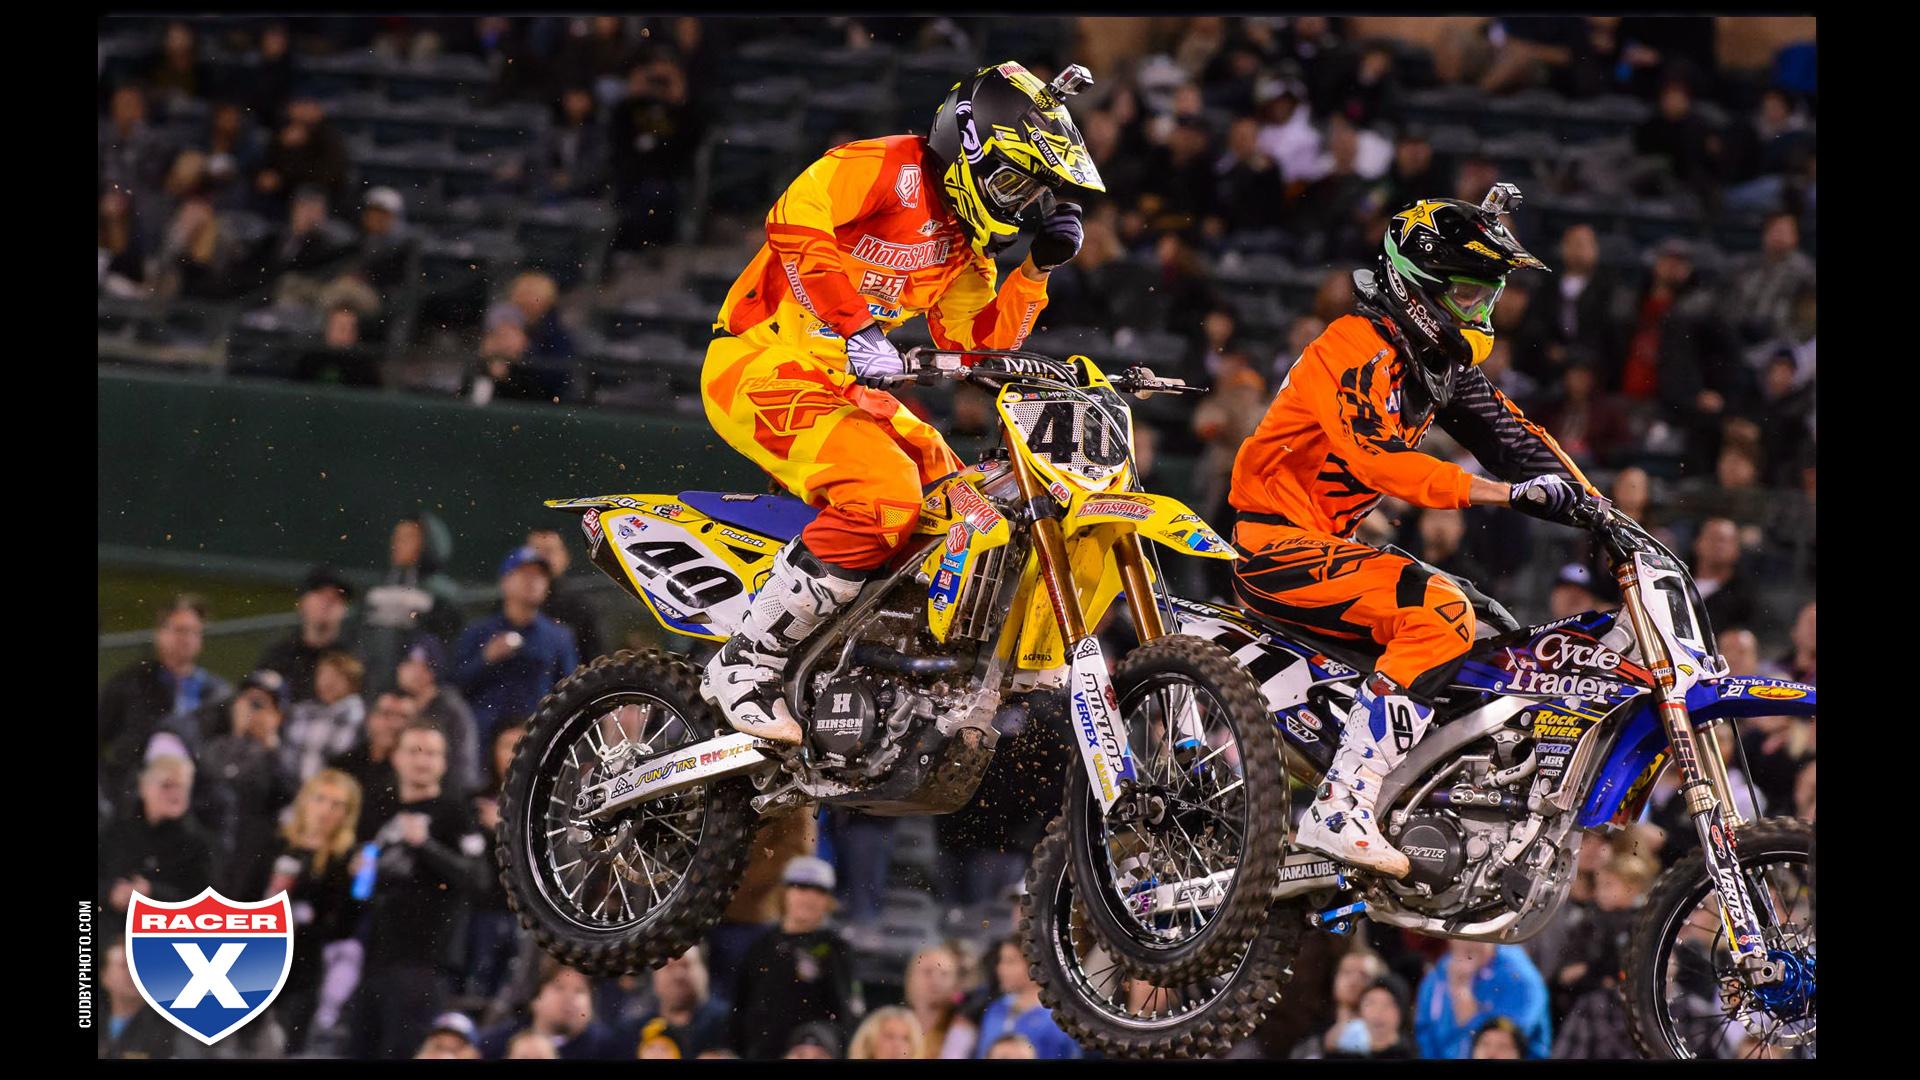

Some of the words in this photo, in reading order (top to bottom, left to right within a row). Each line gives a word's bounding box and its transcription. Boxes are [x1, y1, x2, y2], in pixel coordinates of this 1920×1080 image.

[862, 273, 904, 297] ヨシムラ
[1405, 304, 1439, 344] Trader
[1416, 304, 1441, 333] Cycle
[1026, 402, 1128, 467] 40
[721, 528, 765, 548] Peick
[626, 541, 744, 609] 40
[1531, 614, 1583, 636] YAMAHA
[1023, 653, 1053, 662] ACERBIS
[1535, 633, 1622, 671] Cycle
[1506, 656, 1619, 705] Trader
[1720, 676, 1765, 687] Cycle
[1766, 679, 1817, 693] Trade
[832, 693, 852, 713] H
[816, 718, 863, 729] HINSON
[1073, 691, 1100, 749] VERTEX
[1081, 672, 1125, 774] DUNLOP
[1301, 712, 1319, 728] BELL
[1534, 710, 1577, 726] ROCK
[1532, 724, 1582, 738] RIVER
[1540, 756, 1565, 767] JGR
[1401, 845, 1447, 859] GYTR
[1278, 861, 1336, 882] YAMALUBE
[1720, 867, 1748, 932] VERTEX
